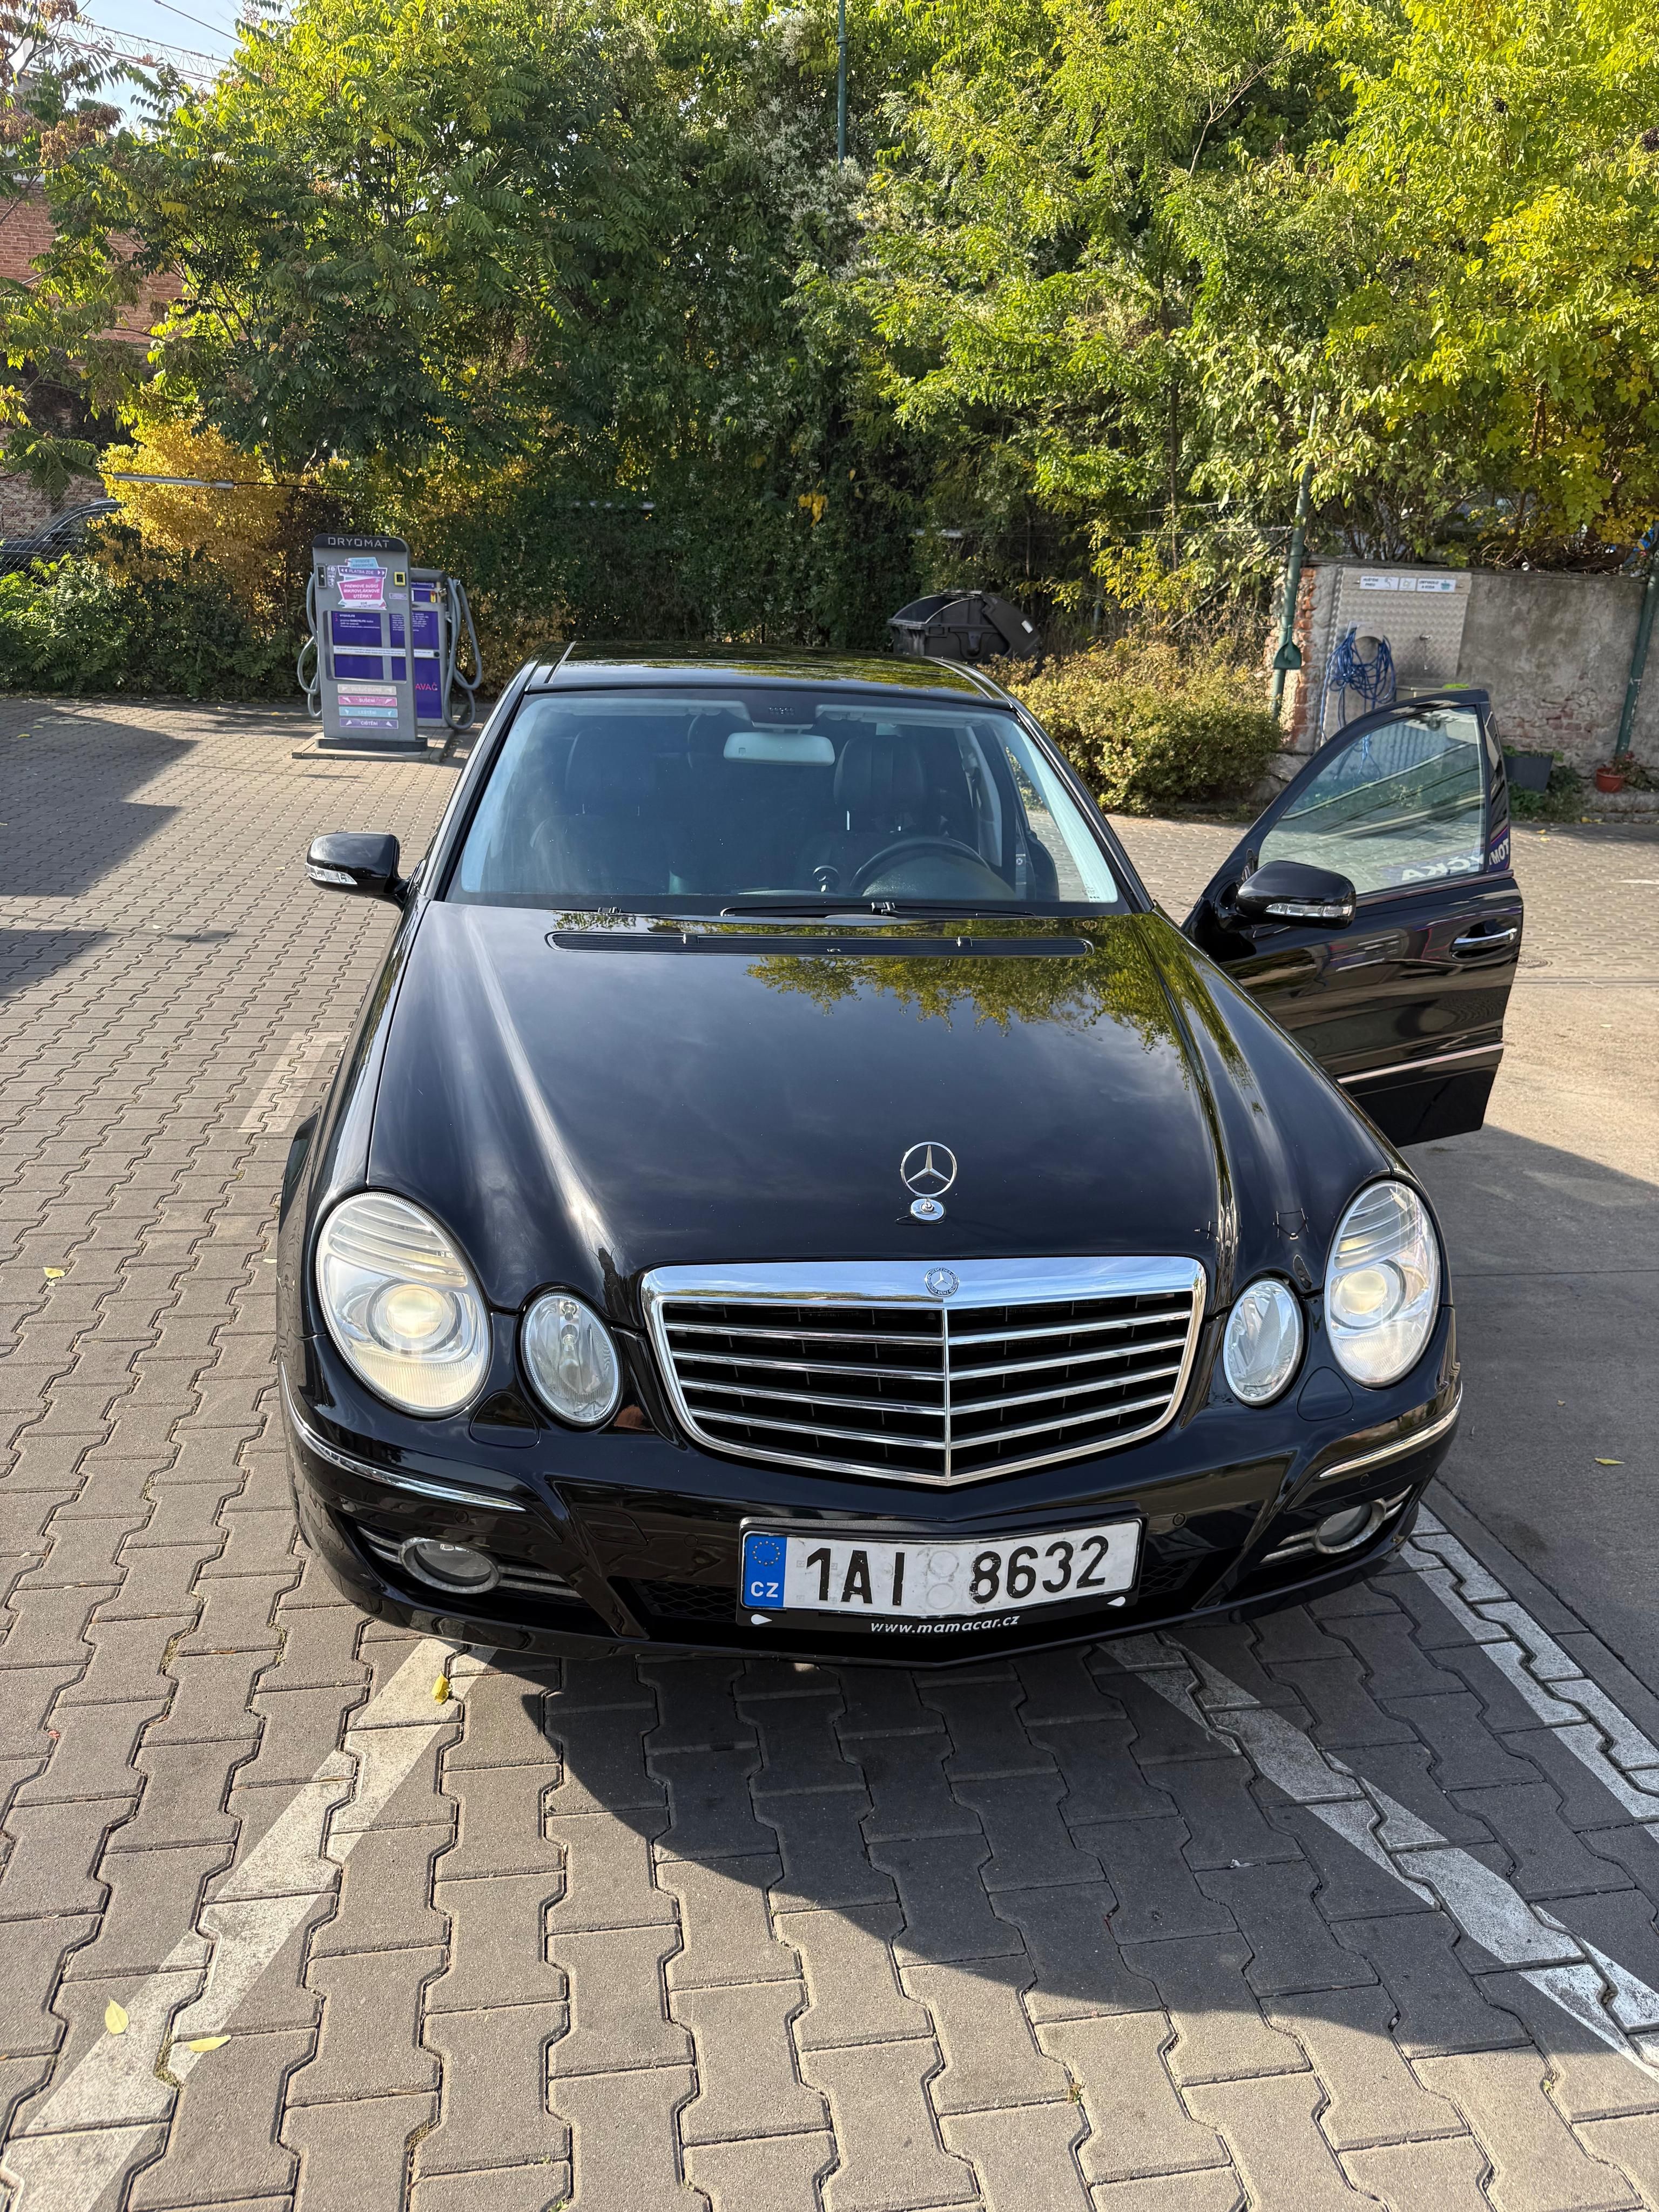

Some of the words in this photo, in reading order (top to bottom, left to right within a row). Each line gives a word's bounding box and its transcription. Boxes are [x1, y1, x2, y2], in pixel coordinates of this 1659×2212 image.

[328, 537, 389, 548] DRYOMAT
[969, 1535, 1109, 1604] 8632
[751, 1581, 779, 1598] CZ
[871, 1615, 1020, 1633] www.mamacar.cz
